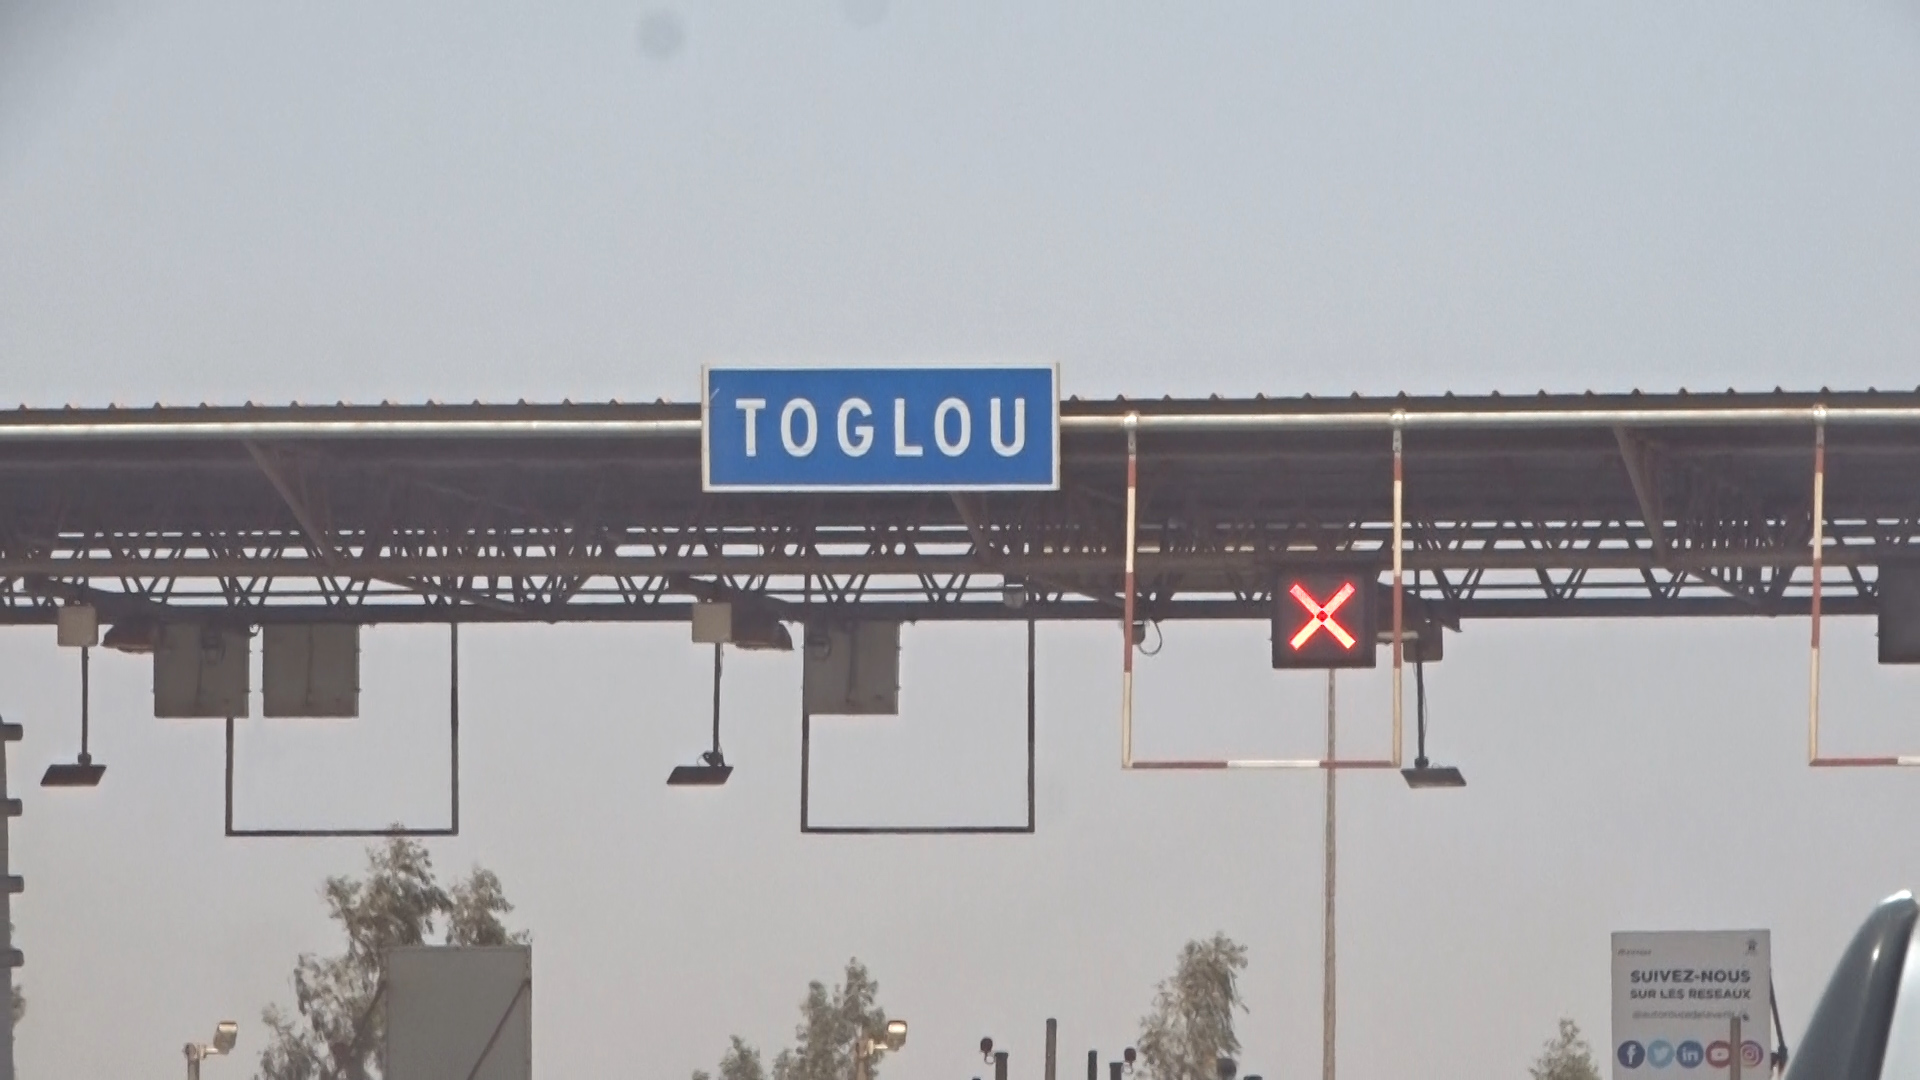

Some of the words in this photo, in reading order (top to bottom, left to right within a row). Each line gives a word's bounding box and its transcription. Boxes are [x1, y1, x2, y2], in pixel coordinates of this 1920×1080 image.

[735, 397, 1026, 457] TOGLOU
[1630, 969, 1751, 984] SUIVEZ-NOUS
[1630, 988, 1657, 999] SUR
[1660, 988, 1685, 999] LES
[1689, 988, 1751, 999] RESEAUX
